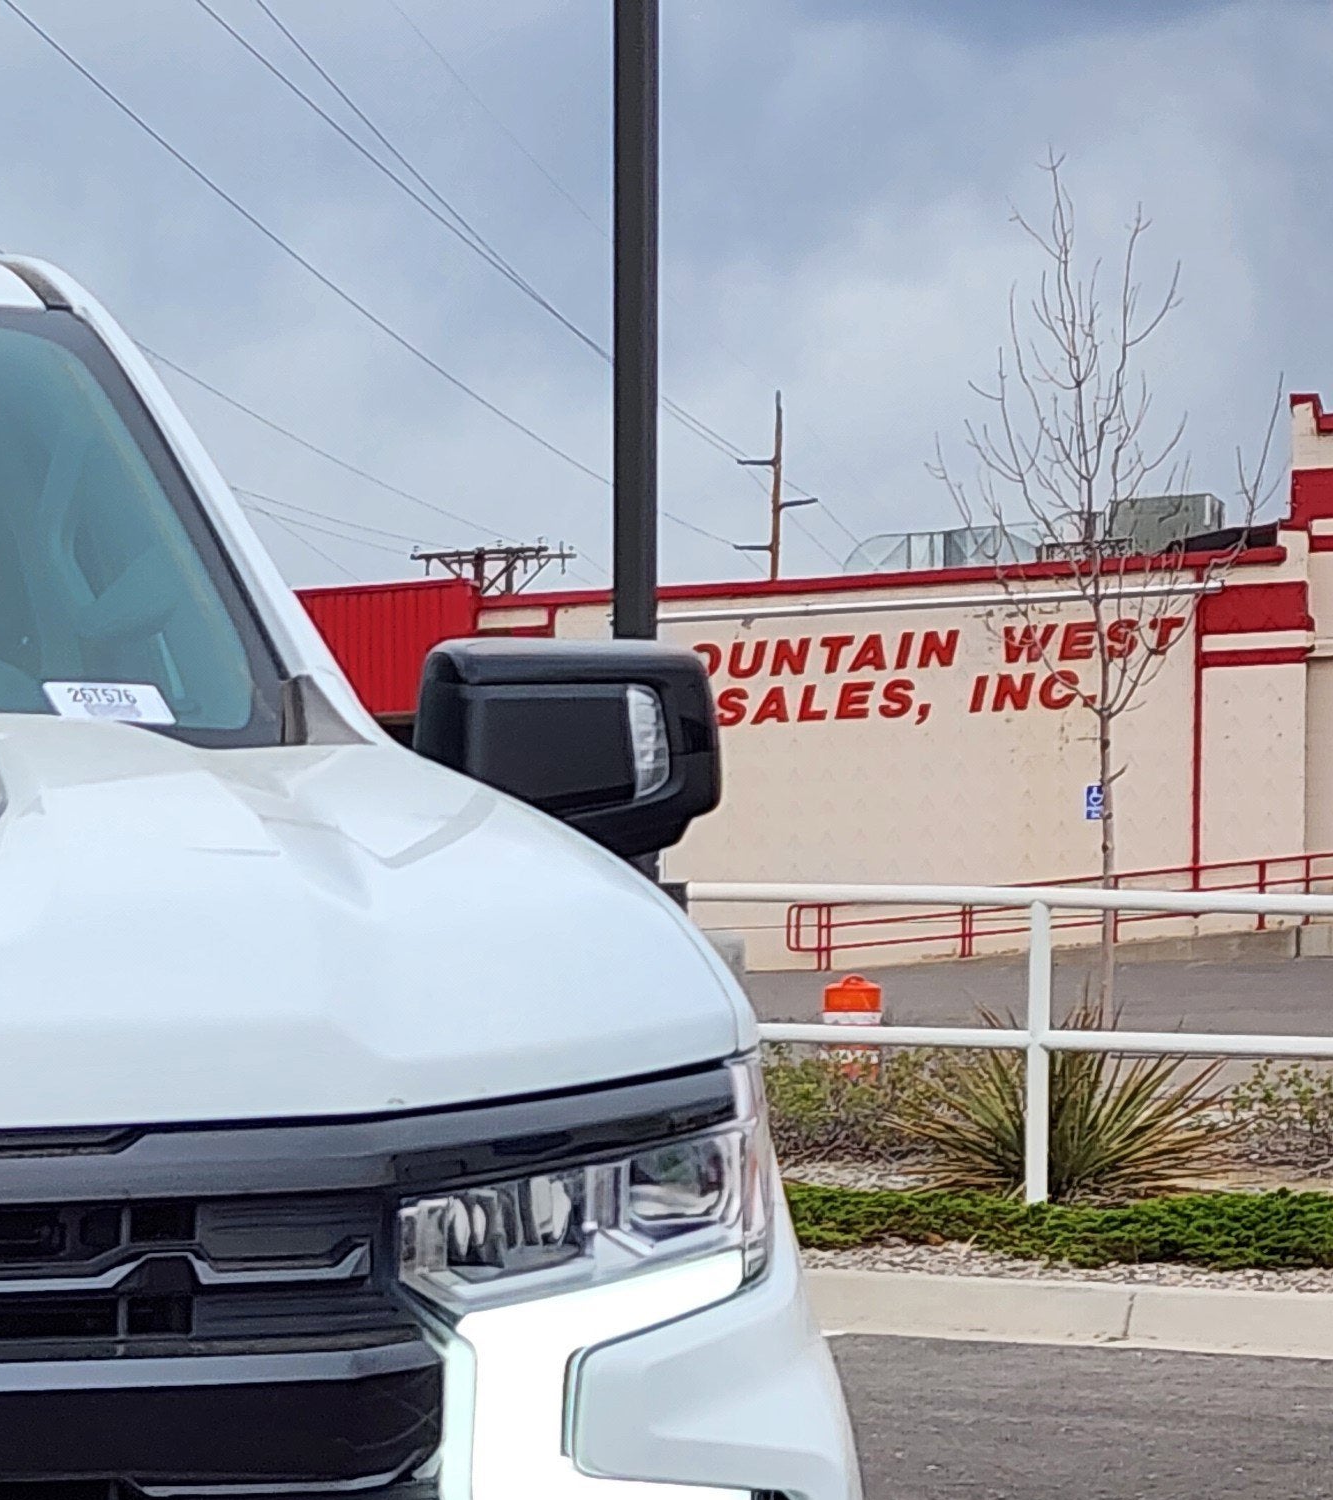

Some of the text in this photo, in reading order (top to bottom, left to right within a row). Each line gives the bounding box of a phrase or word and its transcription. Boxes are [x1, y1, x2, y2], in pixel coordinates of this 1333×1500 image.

[693, 616, 1186, 679] OUNTAIN WEST
[717, 670, 1097, 727] SALES, INC.
